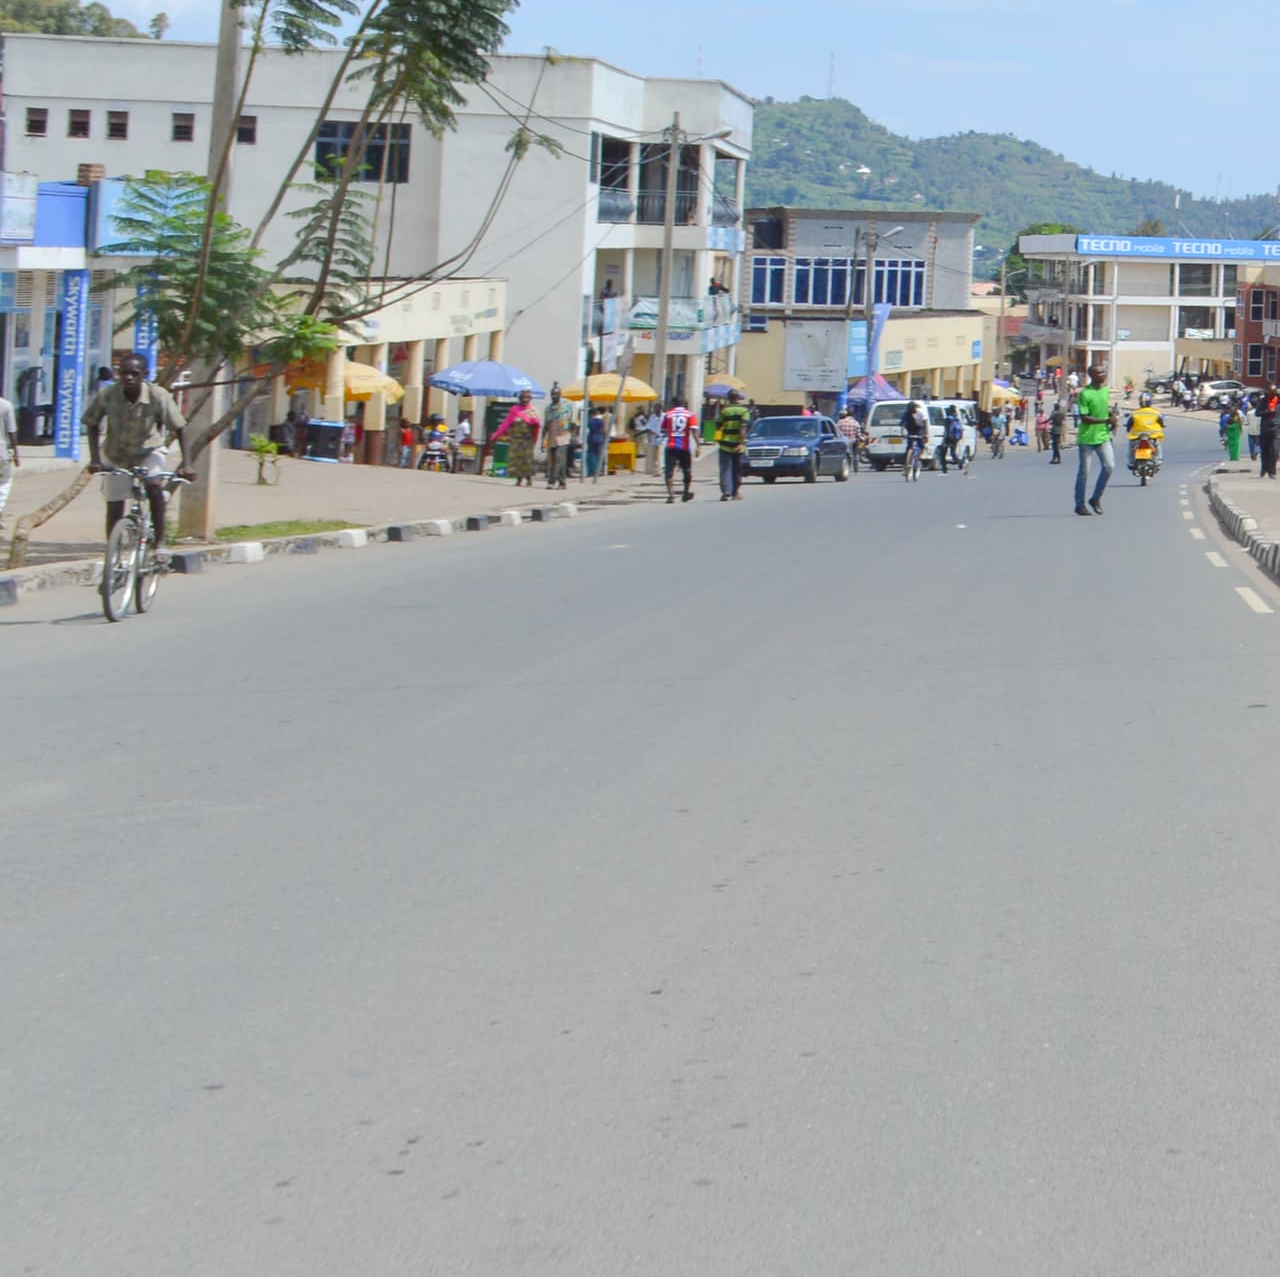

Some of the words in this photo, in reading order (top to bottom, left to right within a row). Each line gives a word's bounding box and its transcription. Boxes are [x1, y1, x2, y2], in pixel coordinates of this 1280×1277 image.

[1080, 238, 1131, 252] TECNO
[1173, 241, 1222, 255] TECNO
[63, 275, 82, 356] Skyworth
[56, 368, 76, 449] Skyworth
[671, 414, 688, 437] 19
